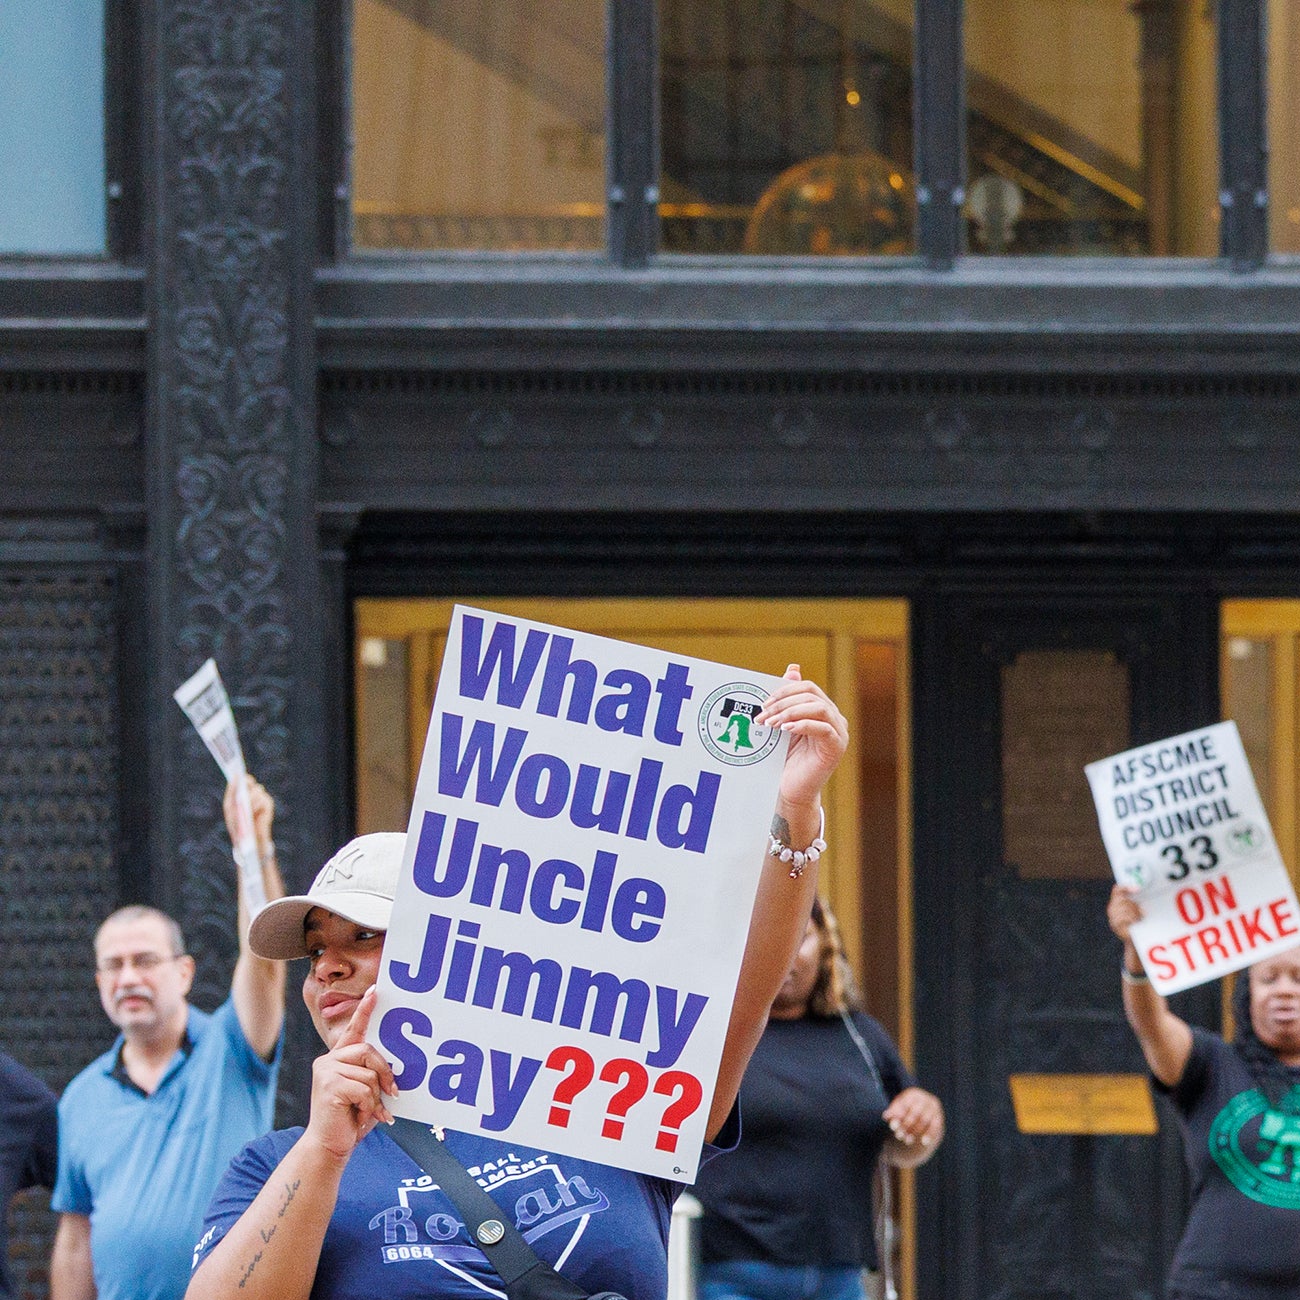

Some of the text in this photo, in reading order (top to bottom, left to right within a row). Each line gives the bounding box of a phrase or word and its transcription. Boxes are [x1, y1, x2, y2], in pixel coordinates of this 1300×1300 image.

[459, 614, 694, 747] What
[733, 702, 754, 714] DC33
[438, 712, 722, 855] Would
[1113, 735, 1217, 788] AFSCME
[1113, 764, 1229, 820] DISTRICT
[1122, 797, 1239, 850] COUNCIL
[412, 810, 667, 944] Uncle
[1160, 835, 1219, 882] 33
[1175, 875, 1238, 926] ON
[1148, 898, 1298, 982] STRIKE
[388, 913, 710, 1069] Jimmy
[378, 1007, 703, 1154] Say???
[368, 1175, 602, 1244] Roan
